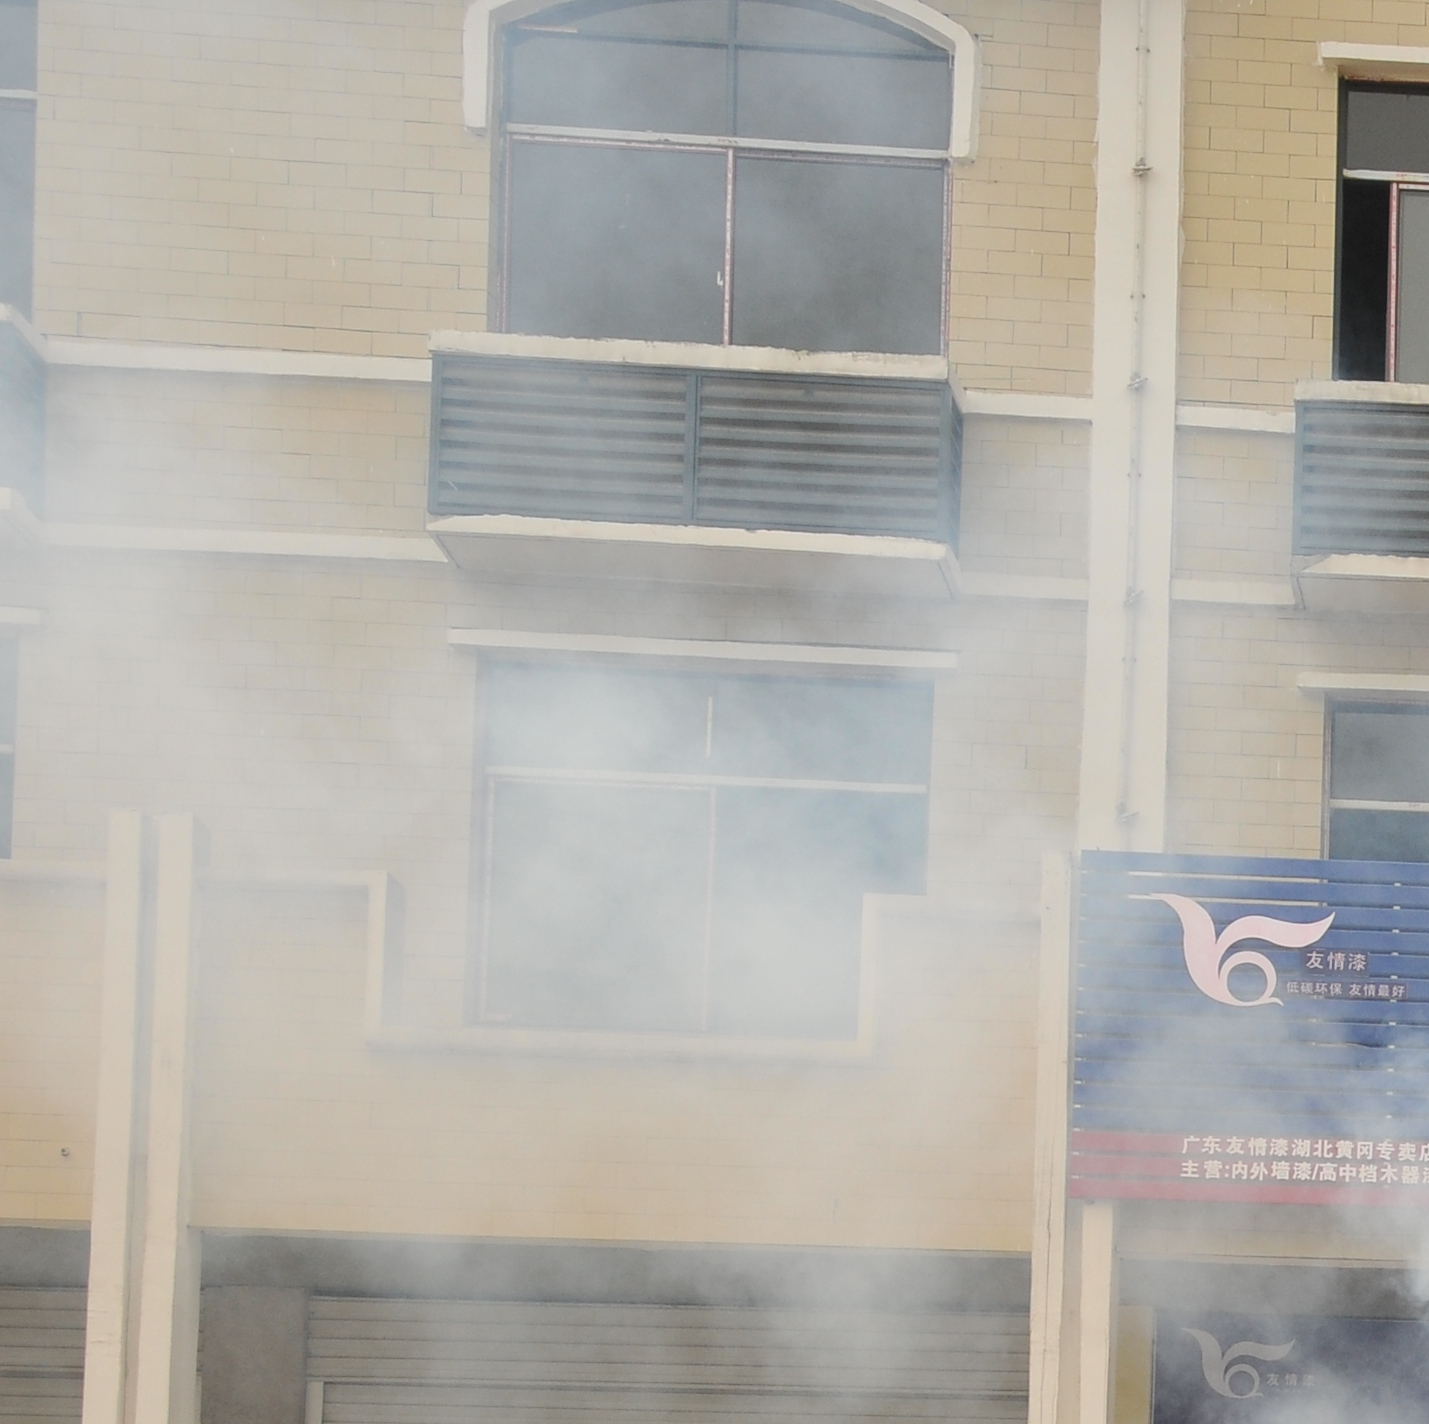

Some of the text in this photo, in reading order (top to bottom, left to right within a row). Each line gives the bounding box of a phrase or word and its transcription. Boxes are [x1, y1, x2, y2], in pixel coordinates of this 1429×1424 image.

[1306, 950, 1368, 972] 友情漆
[1286, 981, 1406, 998] 低碳环保 友情最好
